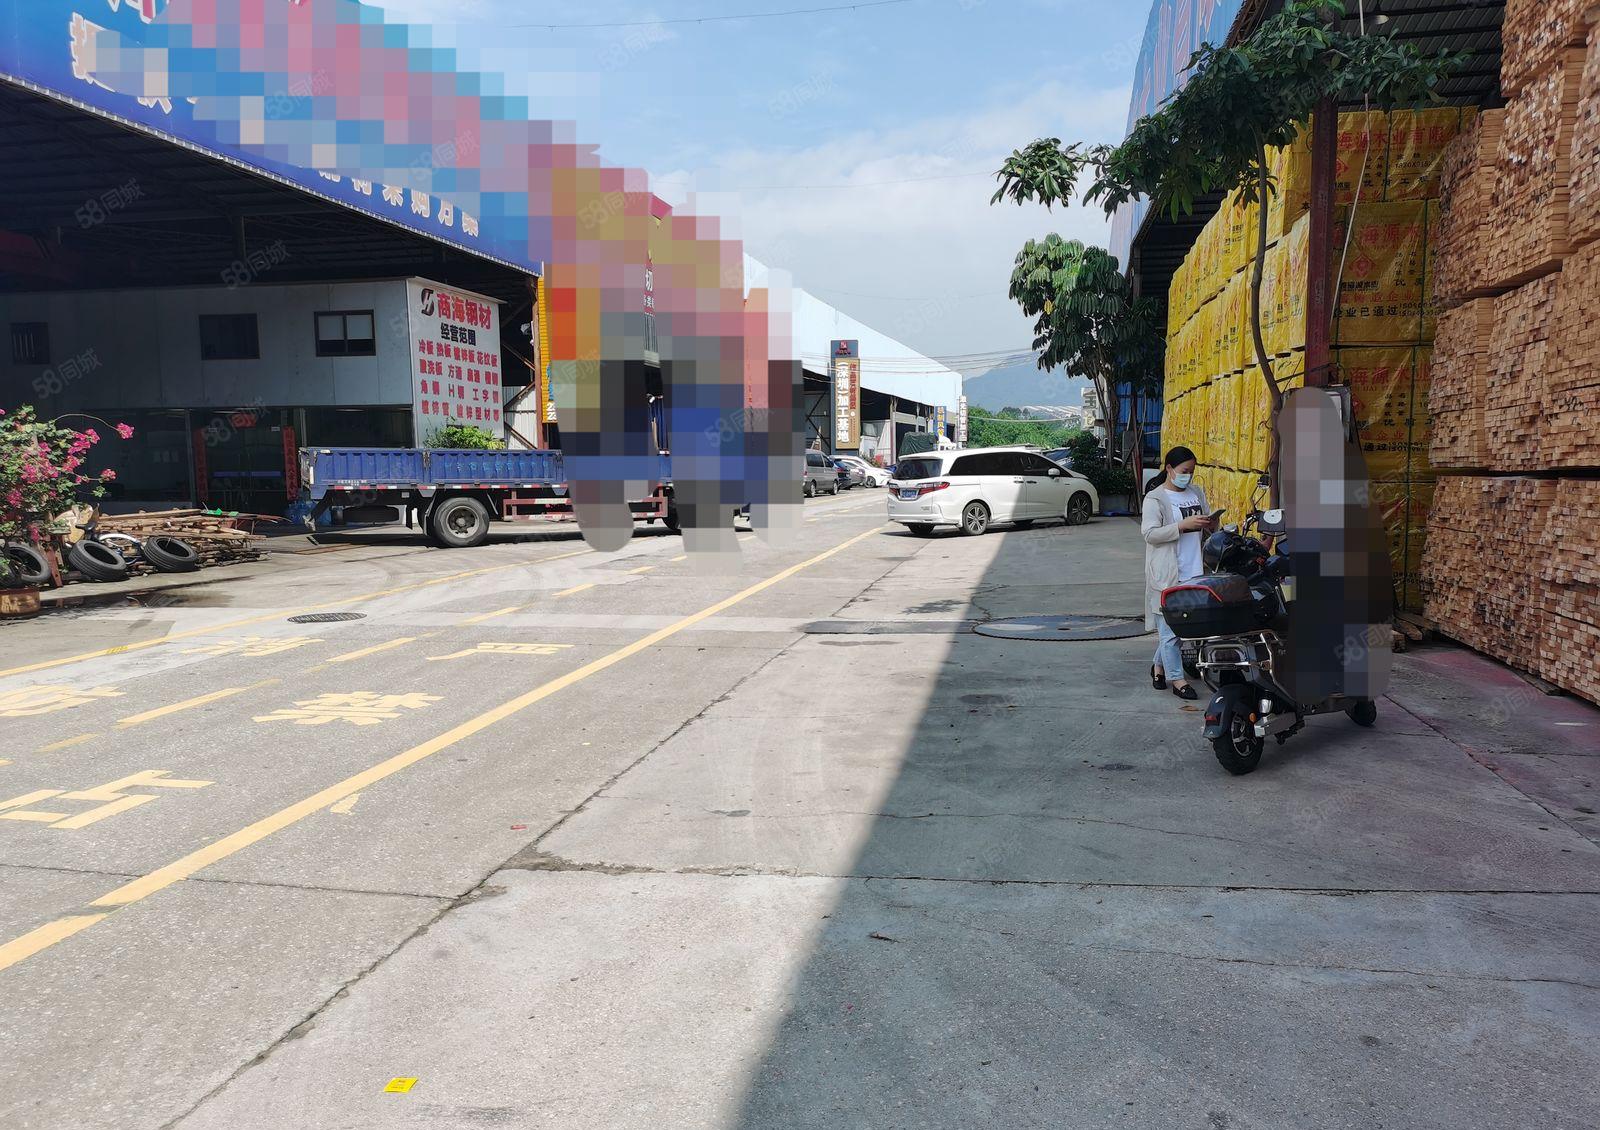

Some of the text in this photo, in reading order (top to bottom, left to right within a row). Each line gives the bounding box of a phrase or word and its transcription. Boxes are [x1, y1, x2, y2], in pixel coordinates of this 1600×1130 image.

[436, 293, 492, 330] 商海钢材
[440, 322, 477, 346] 经营范围
